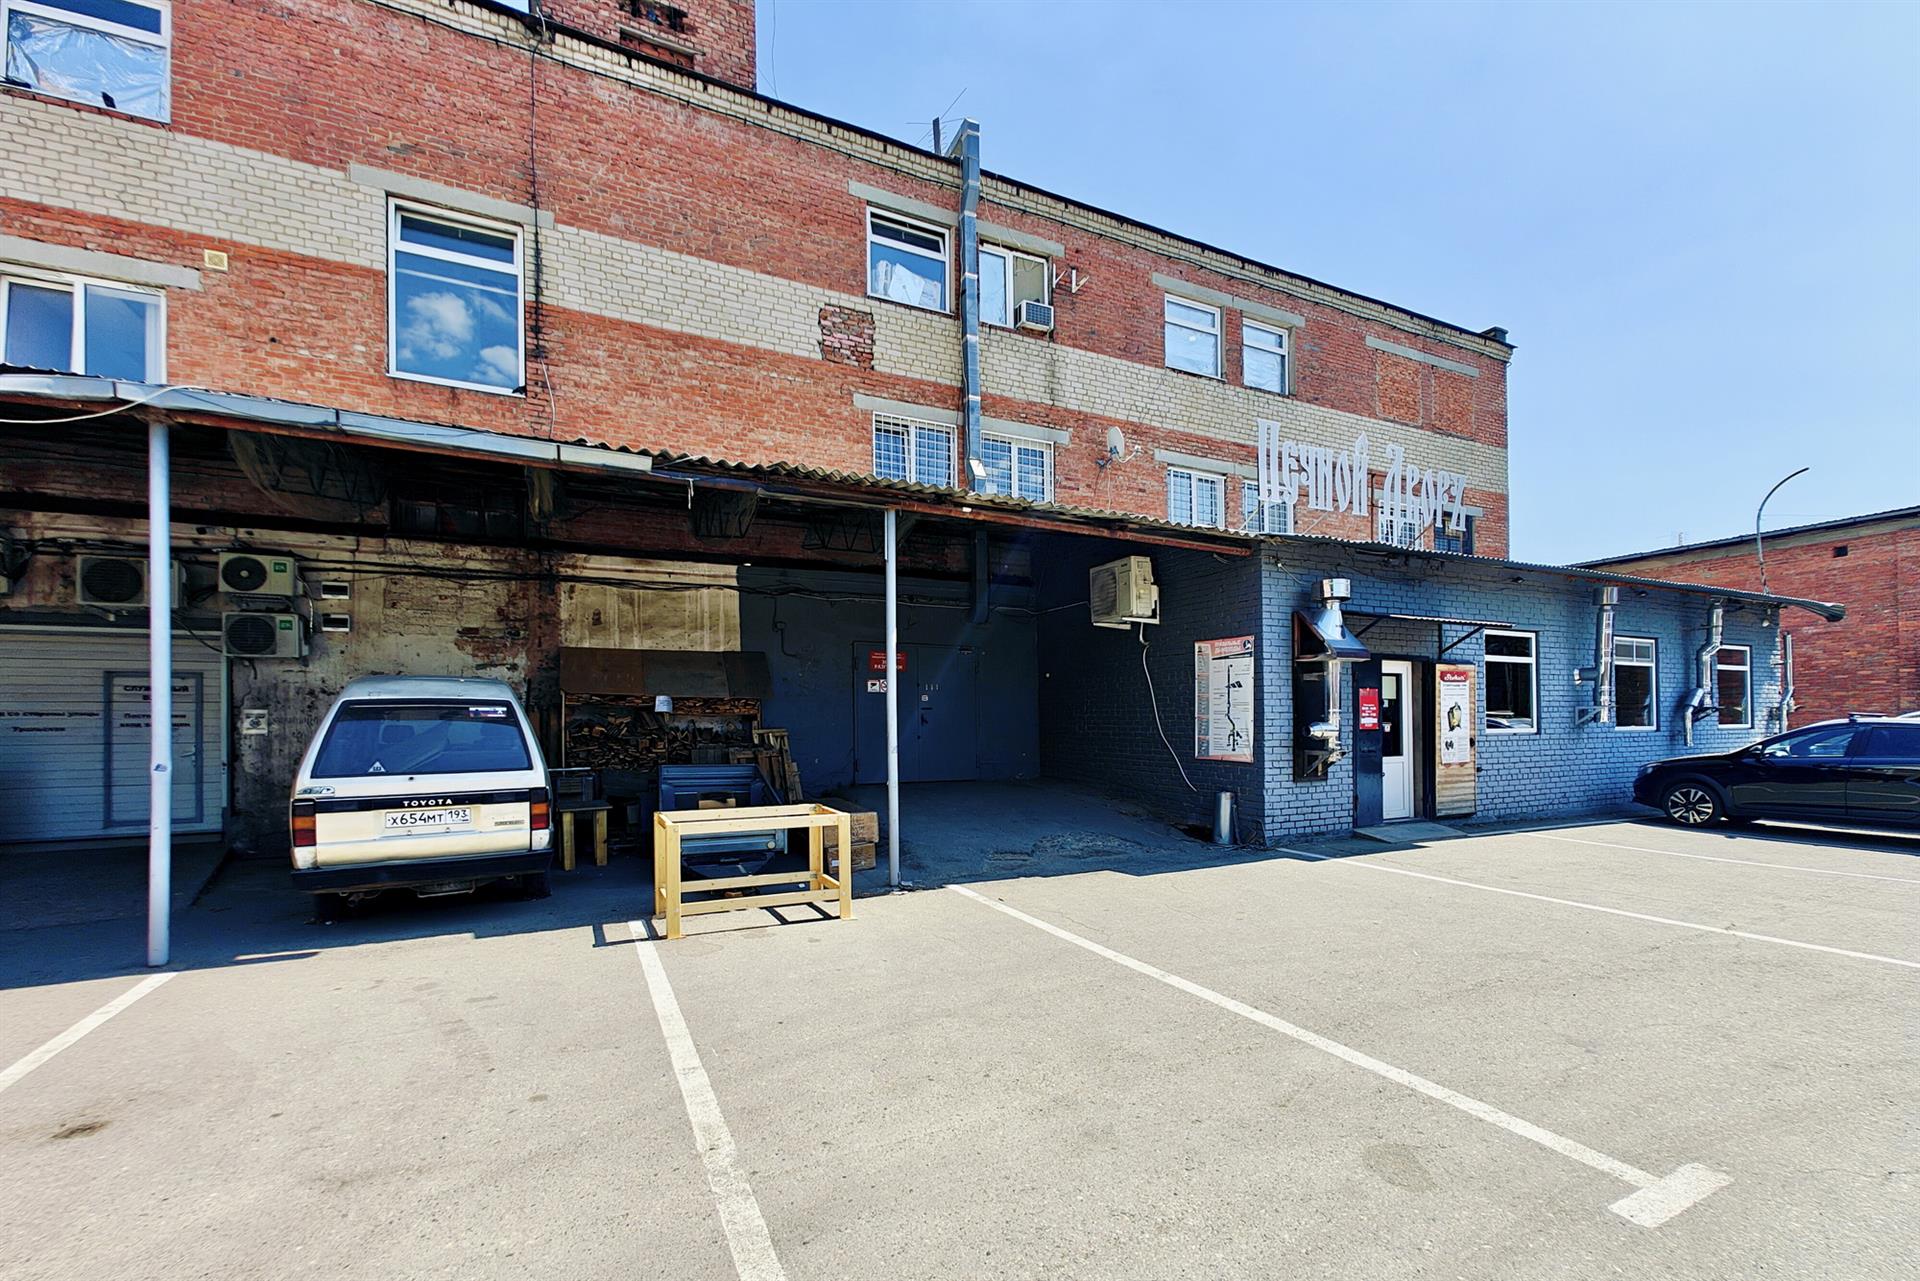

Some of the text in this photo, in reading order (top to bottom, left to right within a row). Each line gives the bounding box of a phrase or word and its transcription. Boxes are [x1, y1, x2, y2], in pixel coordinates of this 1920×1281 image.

[1256, 418, 1369, 517] Печной
[403, 799, 453, 808] TOYOTA
[448, 809, 468, 819] 193
